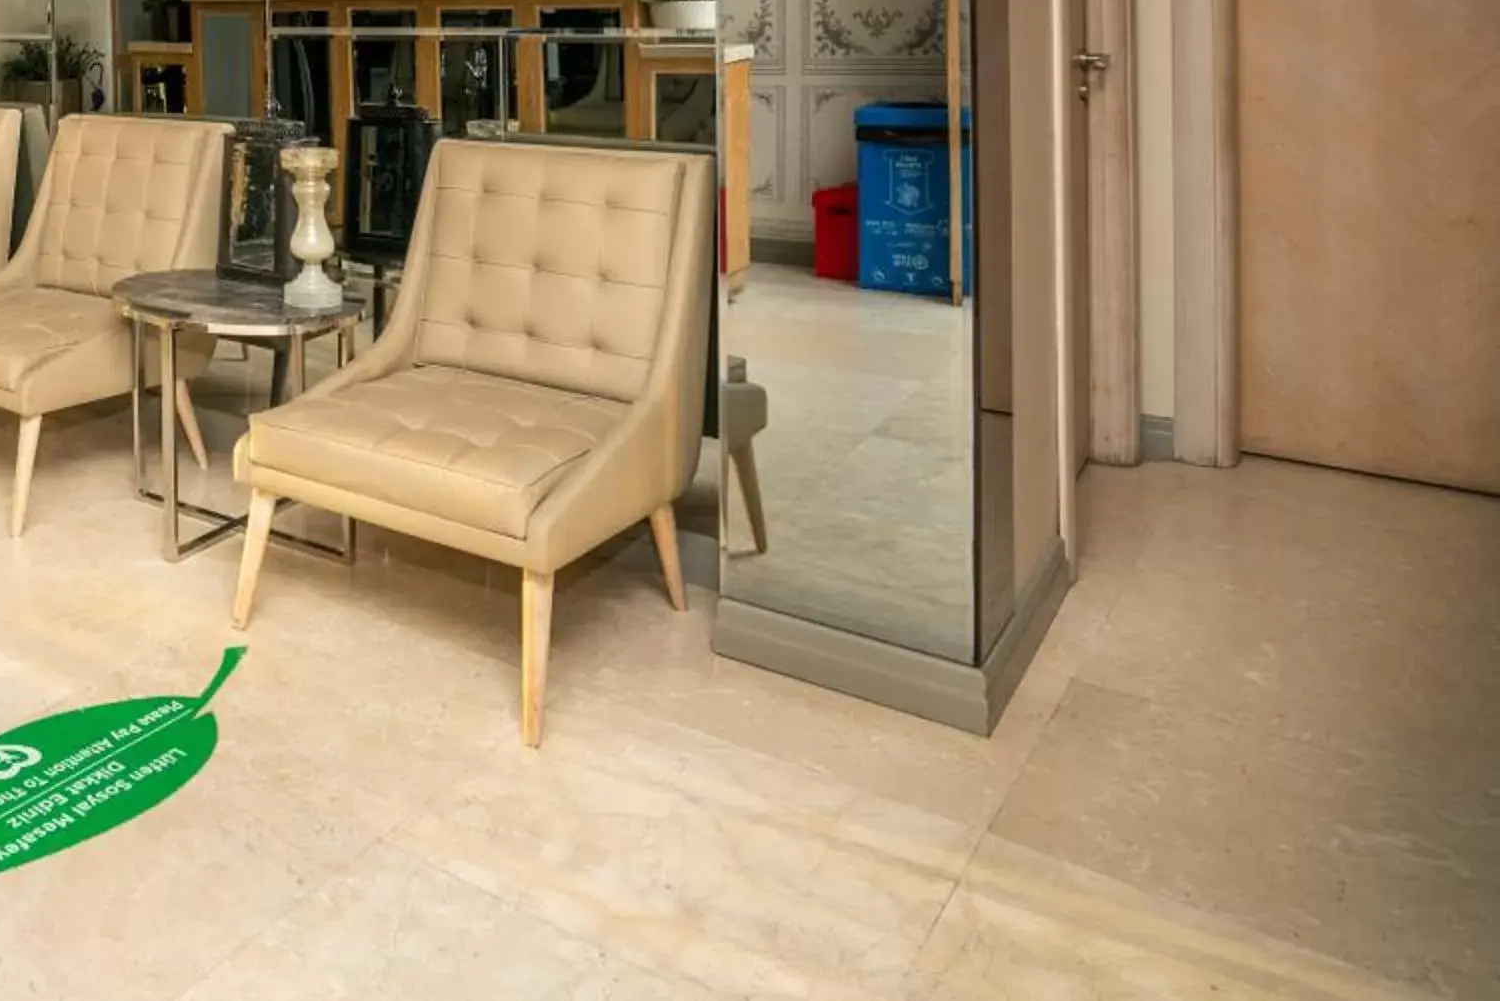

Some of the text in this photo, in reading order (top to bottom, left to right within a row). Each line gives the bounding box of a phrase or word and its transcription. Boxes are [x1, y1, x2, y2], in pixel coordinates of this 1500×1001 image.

[137, 700, 184, 726] Please
[111, 723, 143, 740] Pay
[43, 738, 114, 777] Attention
[129, 747, 188, 781] Lütfen
[6, 760, 126, 828] Dikkat Ediniz
[23, 776, 49, 789] To
[72, 779, 132, 817] Sosyal
